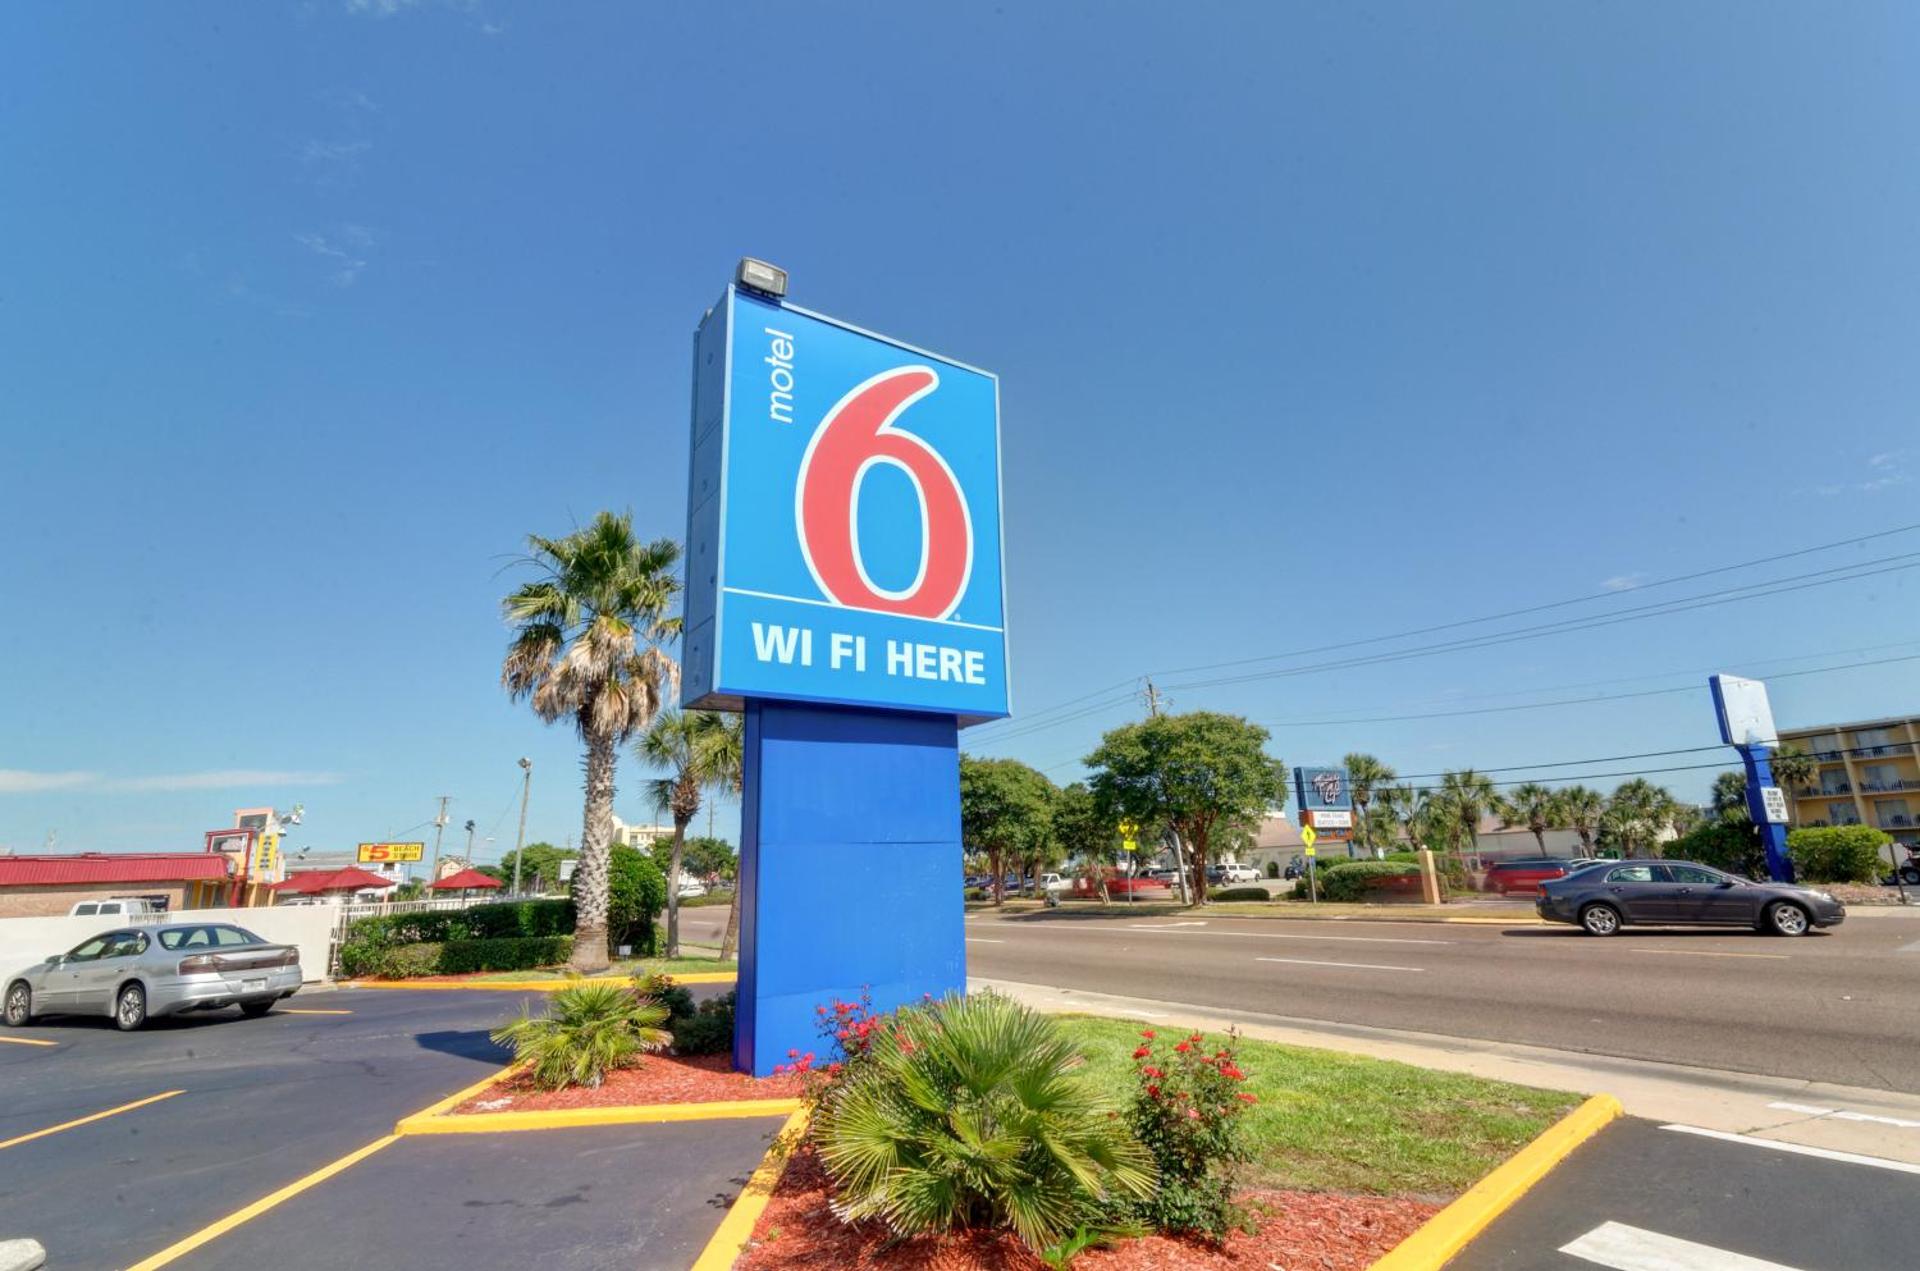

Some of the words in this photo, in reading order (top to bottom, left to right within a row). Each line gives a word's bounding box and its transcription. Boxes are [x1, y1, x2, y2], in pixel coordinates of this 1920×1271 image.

[764, 327, 794, 423] motel
[795, 364, 974, 621] 6
[752, 622, 812, 666] WI
[831, 633, 866, 672] FI
[886, 639, 985, 685] HERE
